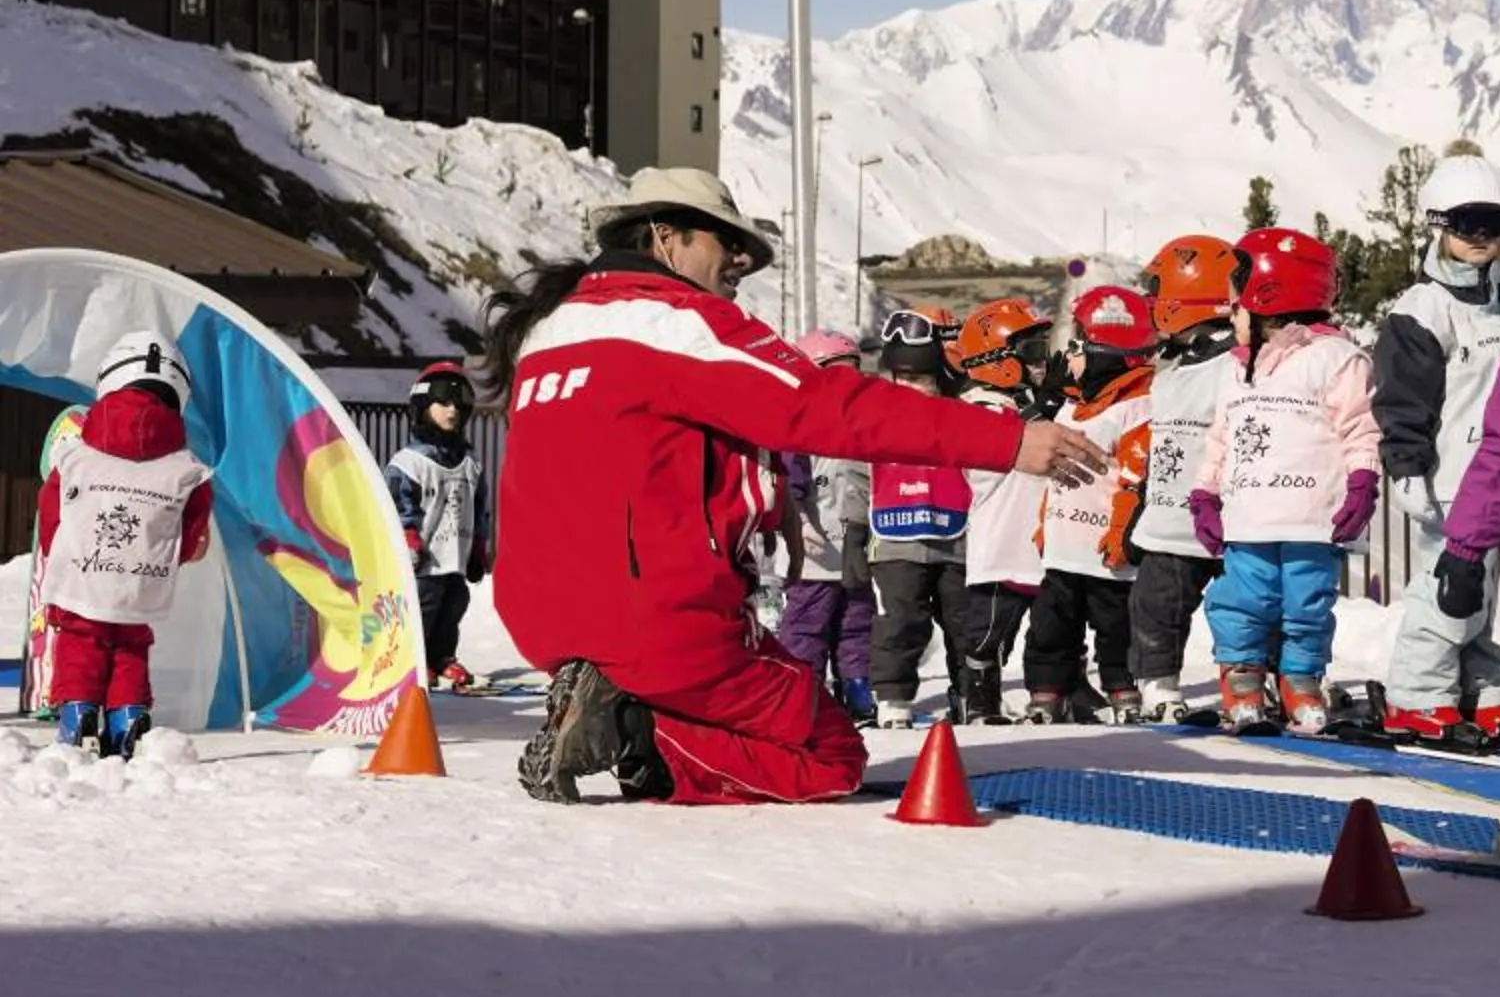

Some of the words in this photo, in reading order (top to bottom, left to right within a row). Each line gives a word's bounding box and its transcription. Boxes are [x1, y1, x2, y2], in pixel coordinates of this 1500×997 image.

[1267, 474, 1318, 489] 2000
[1069, 508, 1109, 528] 2000
[130, 561, 170, 578] 2000
